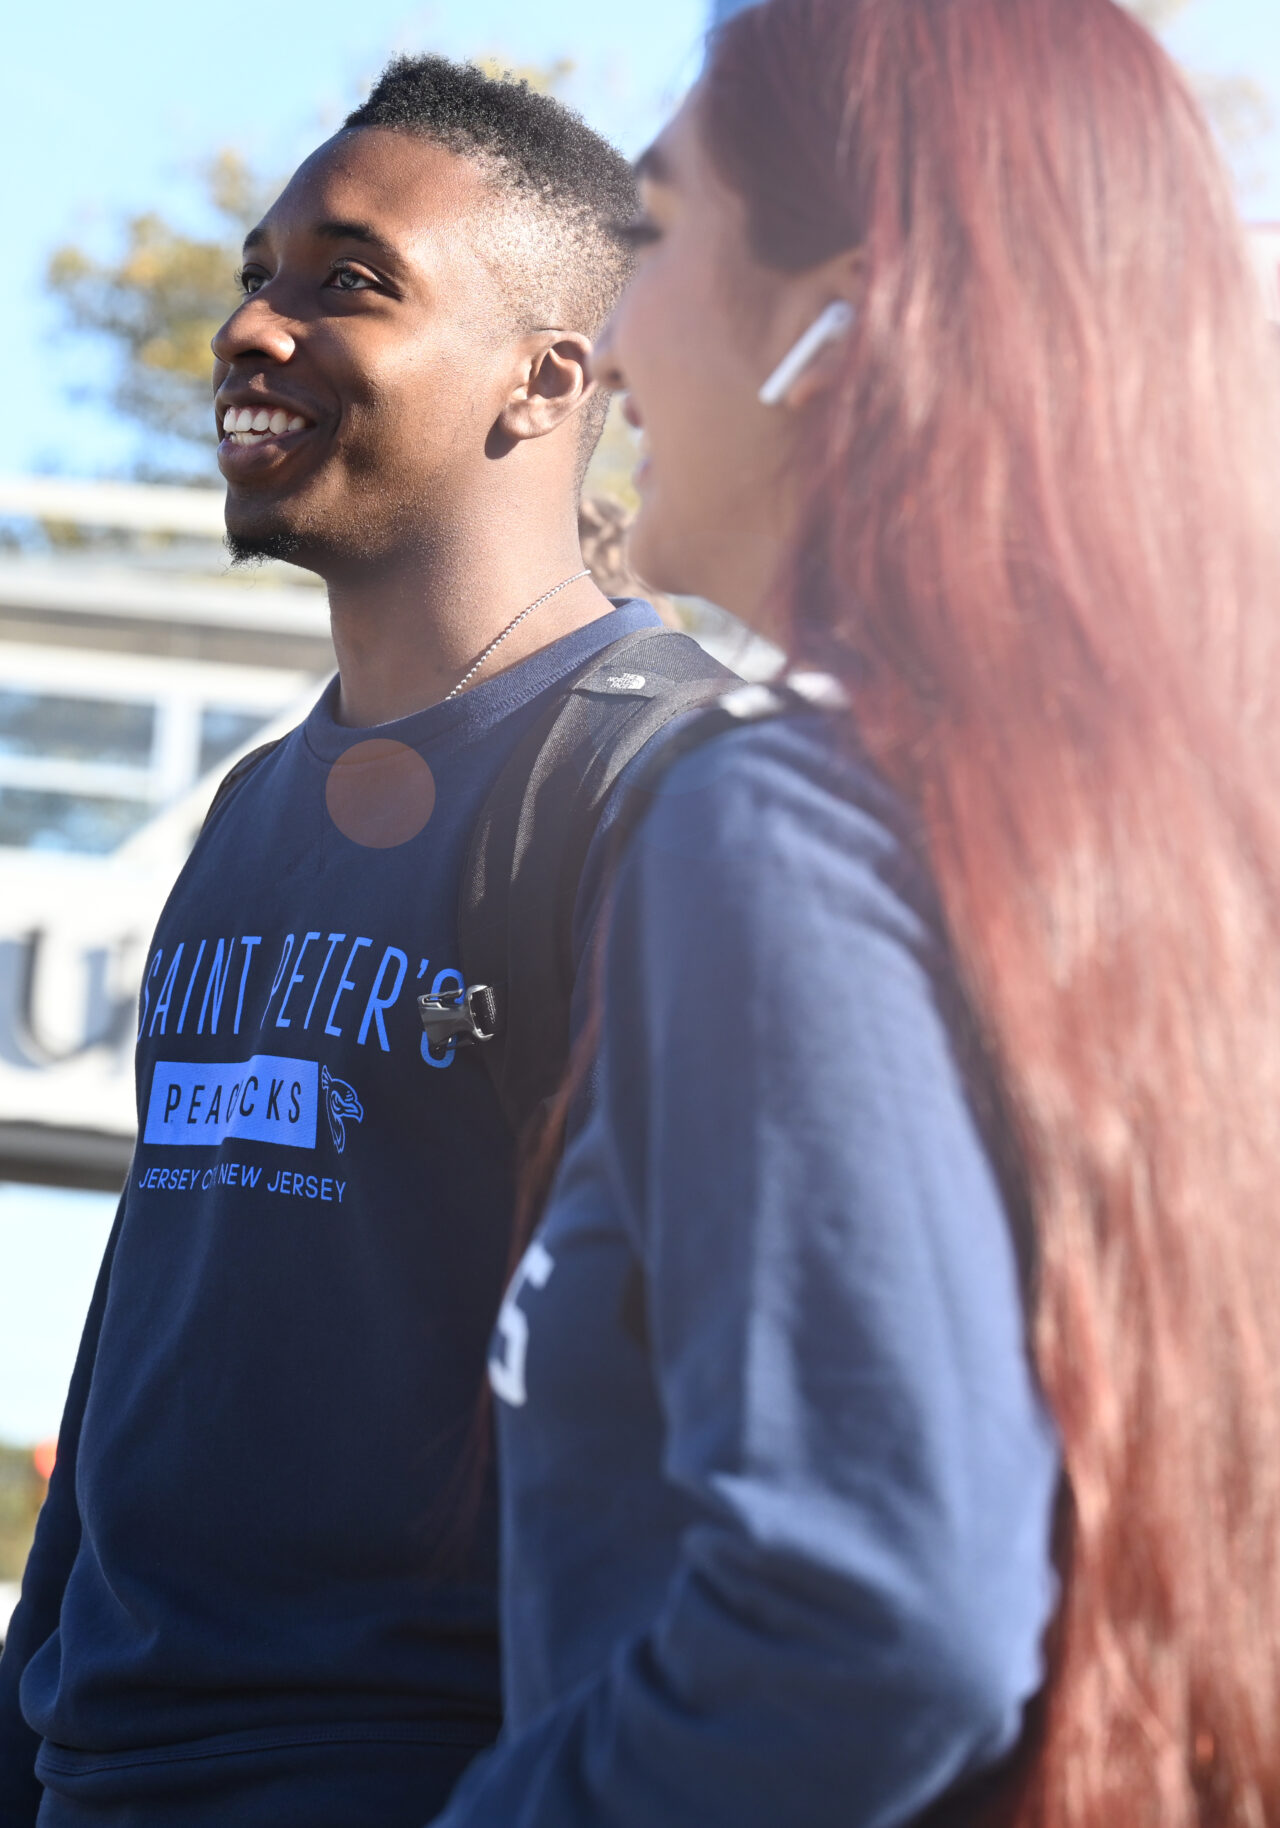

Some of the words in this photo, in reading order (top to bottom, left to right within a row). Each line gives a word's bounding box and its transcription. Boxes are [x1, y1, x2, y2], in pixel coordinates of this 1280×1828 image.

[137, 935, 262, 1042] SAINT
[163, 1075, 302, 1124] PEACCKS
[138, 1167, 201, 1190] JERSEY
[218, 1162, 263, 1188] NEW
[266, 1170, 347, 1204] JERSEY
